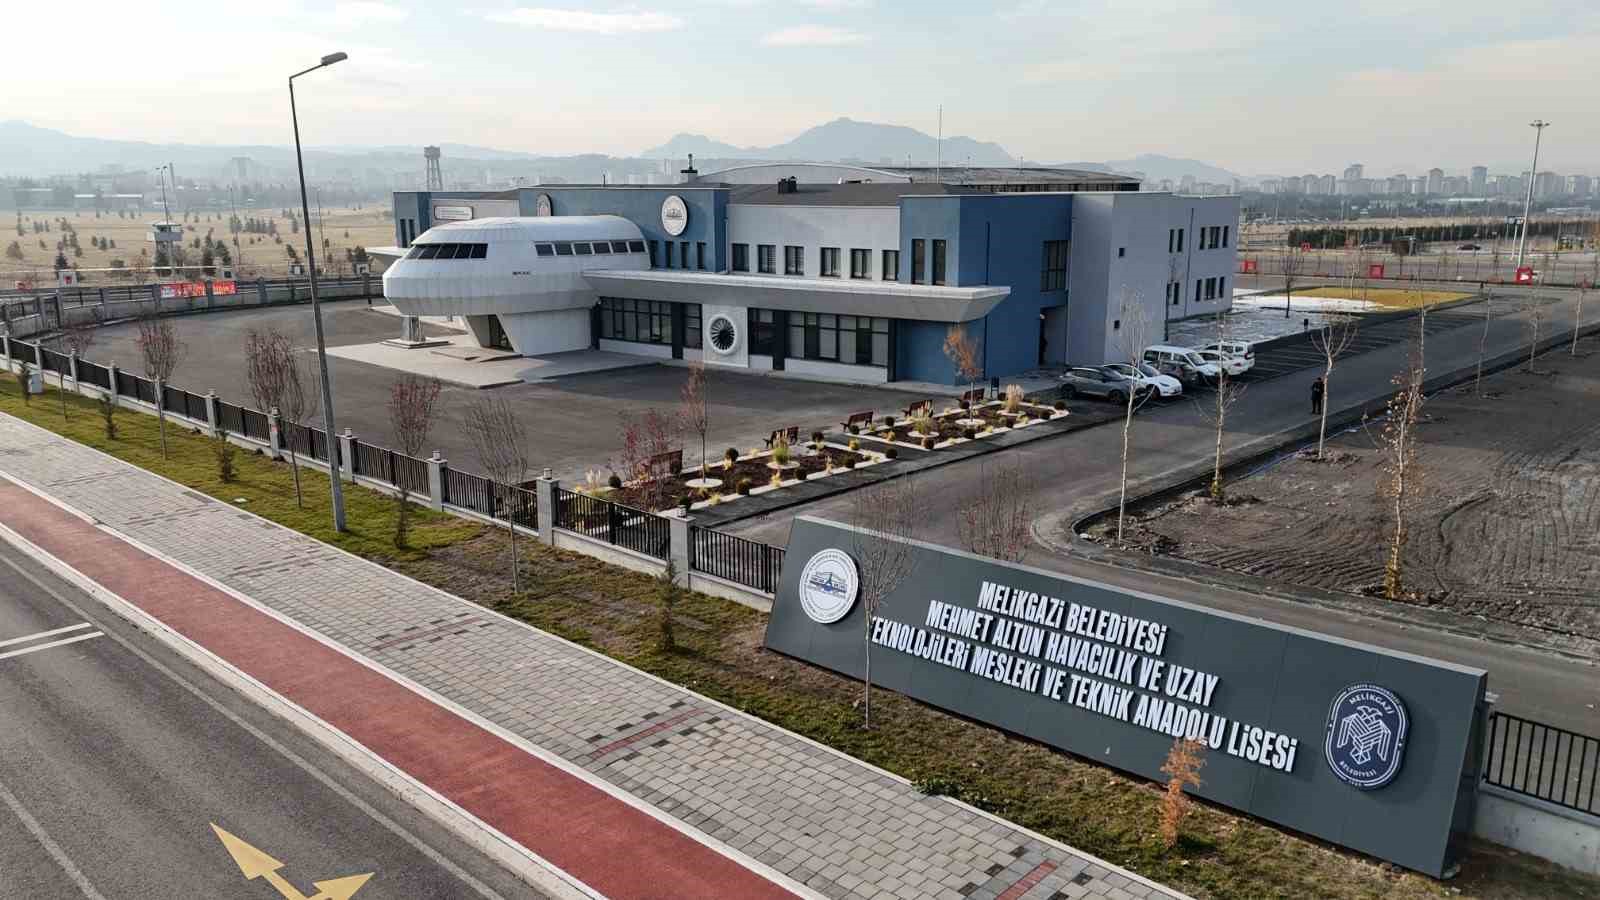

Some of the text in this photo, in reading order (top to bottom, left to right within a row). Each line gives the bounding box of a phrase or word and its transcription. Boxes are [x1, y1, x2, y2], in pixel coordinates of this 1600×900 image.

[871, 616, 970, 670] EKNOLOJİLERİ
[1043, 667, 1066, 700] VE
[1133, 695, 1226, 749] ANADOLU
[925, 600, 1219, 707] MEHMET ALTUN HAVACILIK VE UZAY
